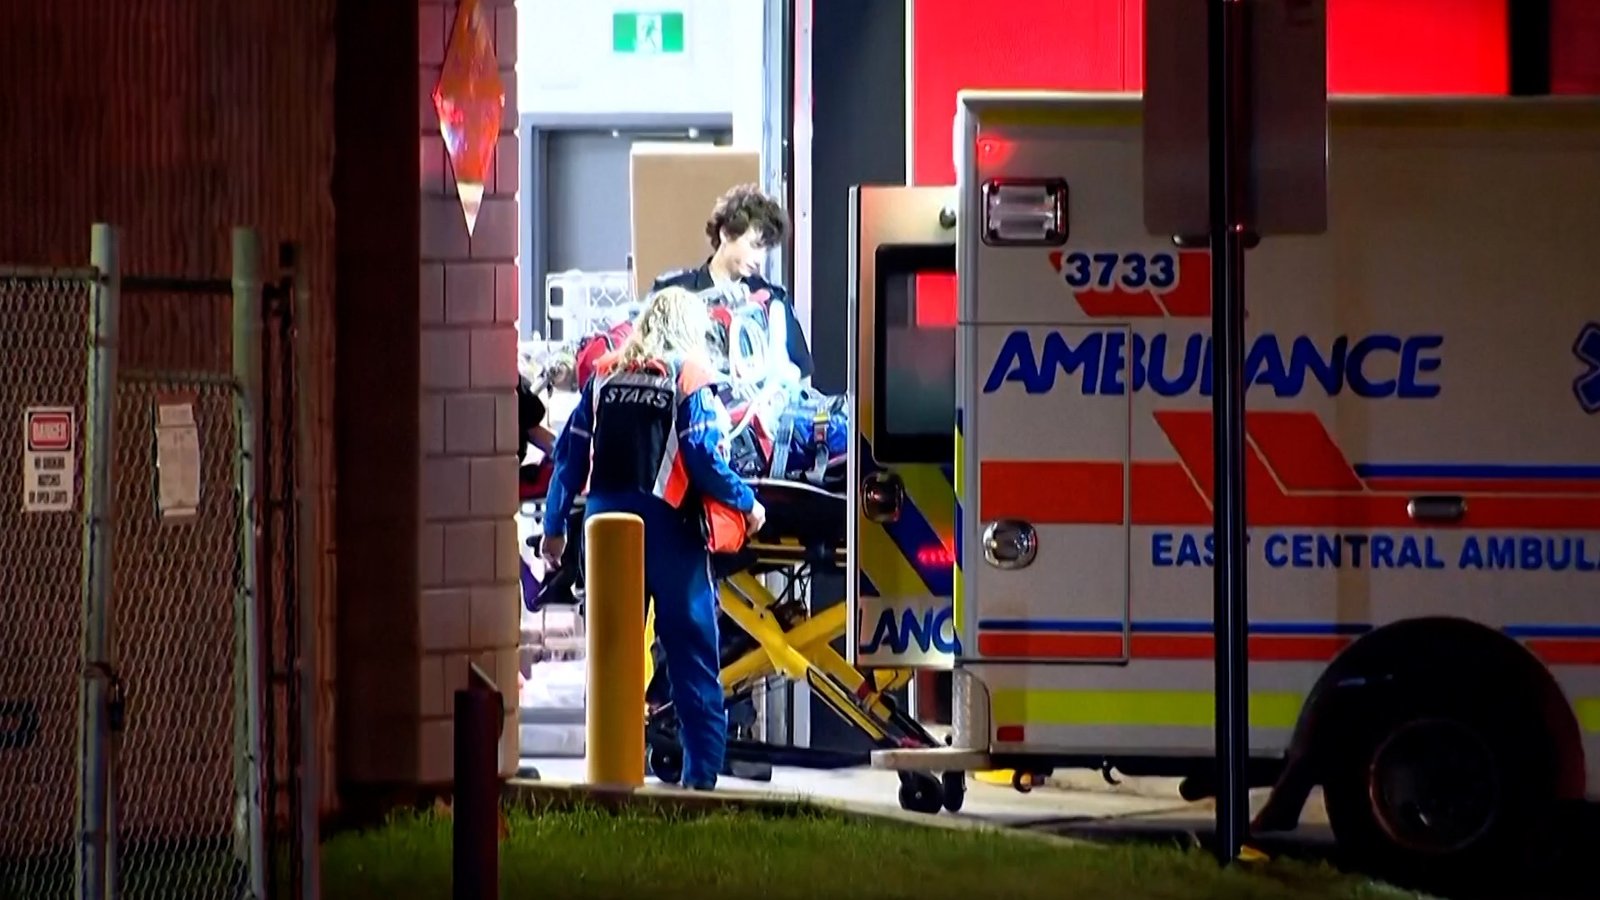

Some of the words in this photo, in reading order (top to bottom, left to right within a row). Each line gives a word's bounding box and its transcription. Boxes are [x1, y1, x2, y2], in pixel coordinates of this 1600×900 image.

[1065, 253, 1175, 288] 3733
[604, 387, 670, 409] STARS
[1152, 533, 1250, 567] EAS
[1264, 533, 1446, 569] CENTRAL
[1458, 534, 1600, 571] AMBUL
